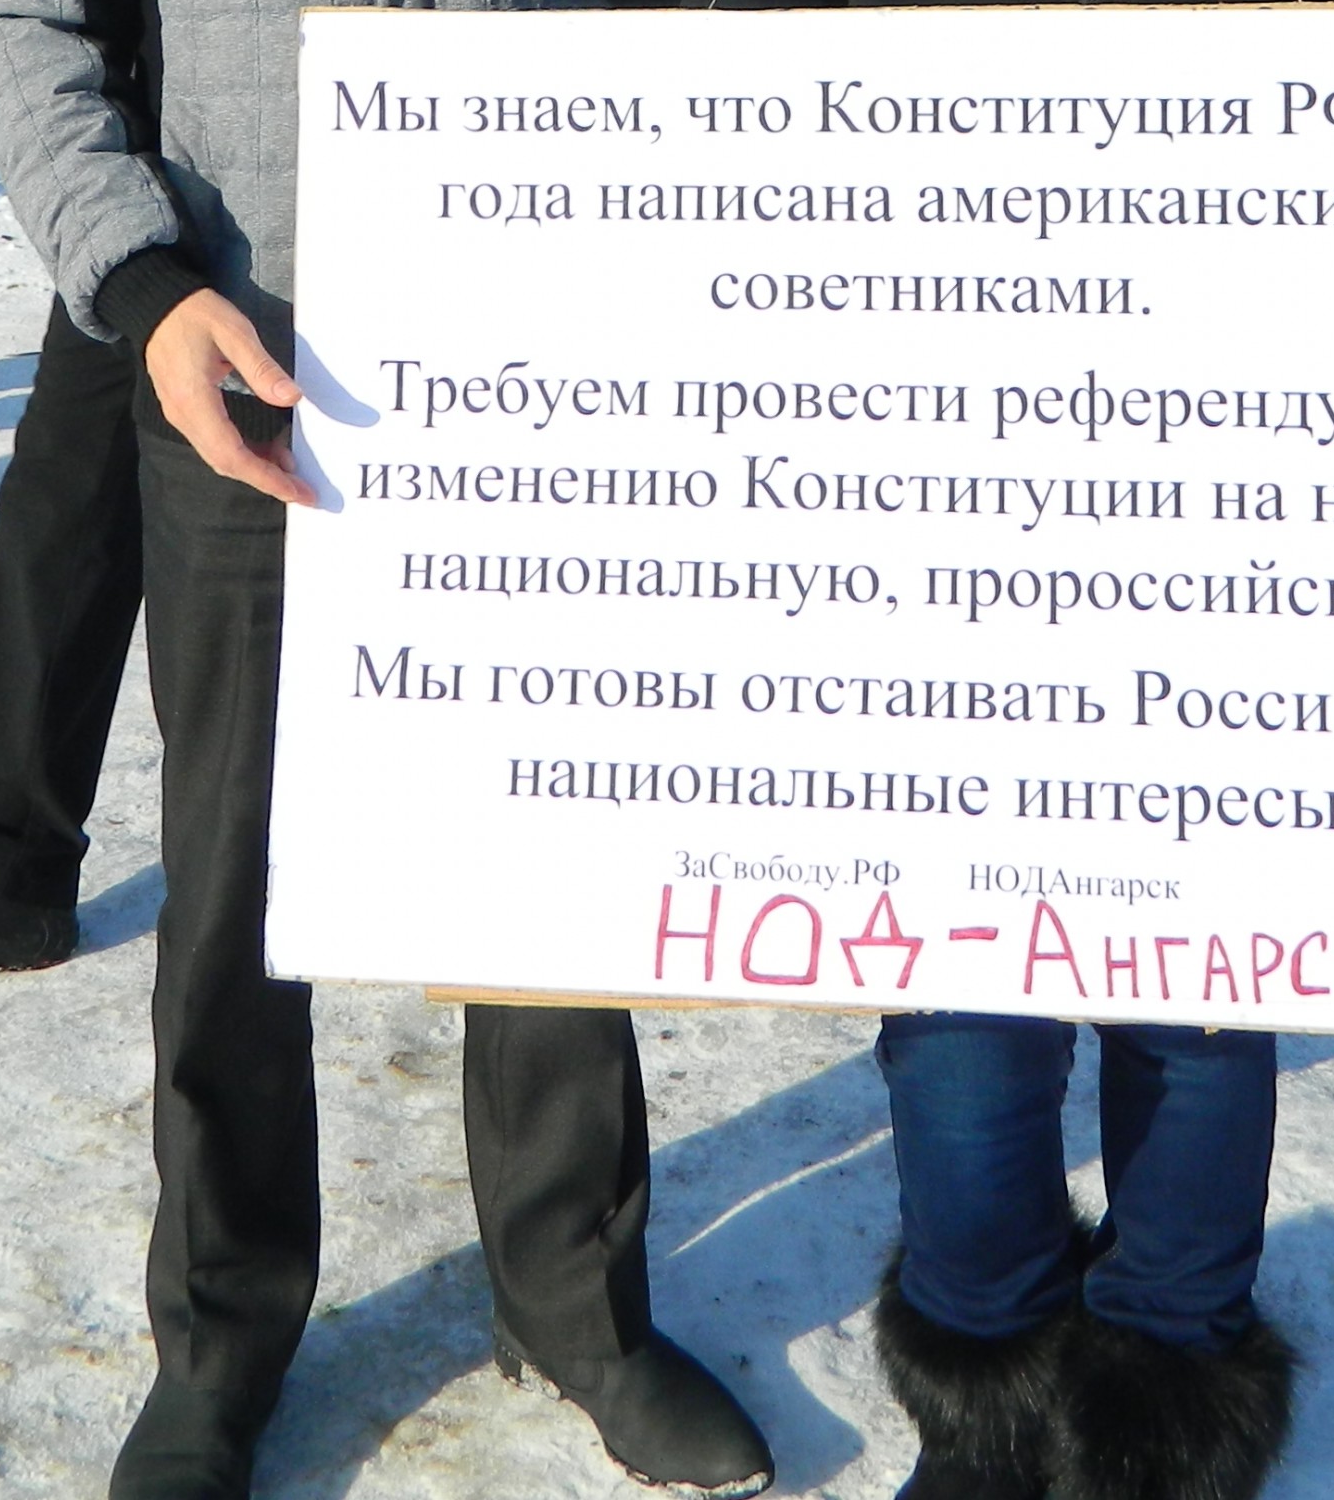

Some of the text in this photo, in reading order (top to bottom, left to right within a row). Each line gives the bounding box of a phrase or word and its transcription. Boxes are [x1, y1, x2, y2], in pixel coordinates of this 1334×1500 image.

[333, 80, 439, 132] Мы
[464, 96, 663, 144] знаем,
[687, 96, 792, 134] что
[816, 80, 1253, 150] Конституция
[438, 183, 575, 228] года
[599, 184, 895, 223] написана
[710, 272, 1152, 316] советниками.
[379, 360, 648, 430] Требуем
[673, 380, 968, 434] провести
[357, 463, 718, 509] изменению
[742, 454, 1185, 533] Конституции
[1212, 482, 1287, 522] на
[400, 553, 899, 617] национальную,
[352, 644, 463, 702] Мы
[489, 665, 716, 711] готовы
[740, 673, 1107, 723] отстаивать
[508, 758, 990, 817] национальные
[674, 850, 1181, 906] ЗаСвободу.РФ НОДАнгарск
